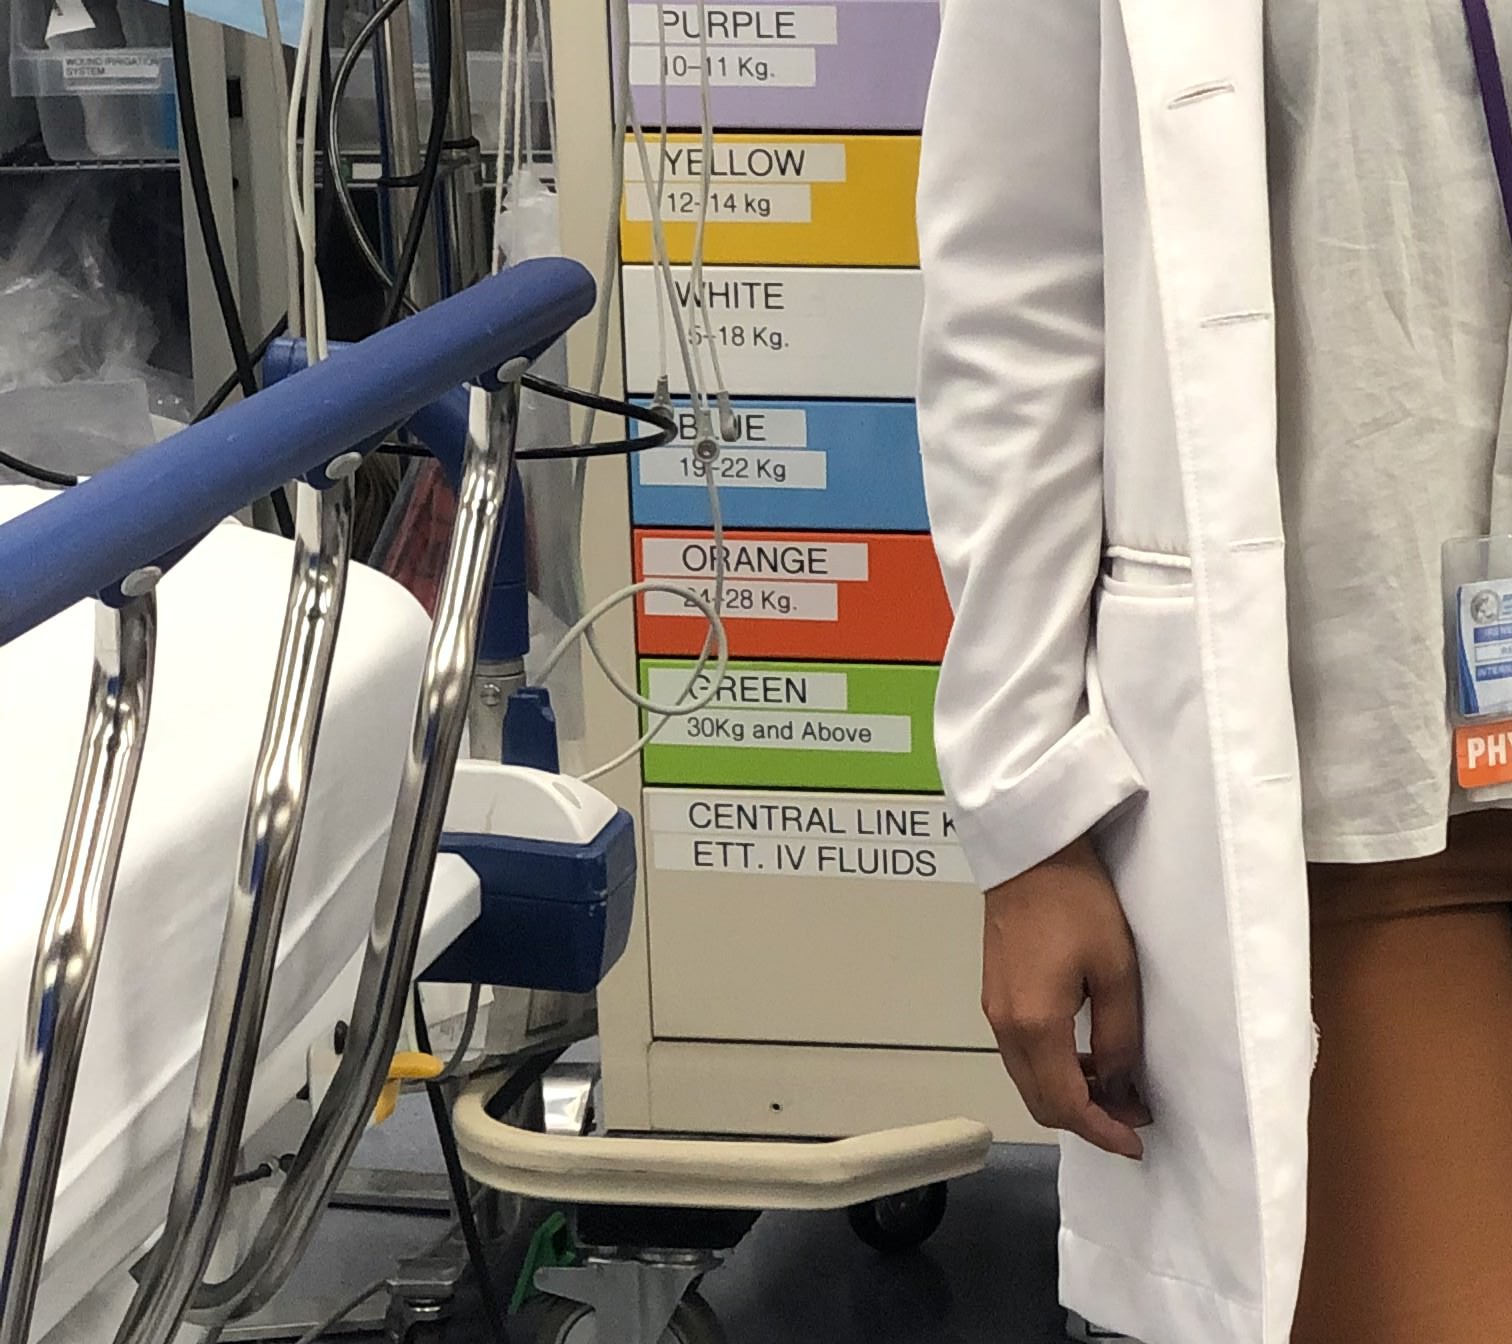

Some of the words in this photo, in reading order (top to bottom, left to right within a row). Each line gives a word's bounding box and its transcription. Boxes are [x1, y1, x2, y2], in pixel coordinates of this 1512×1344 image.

[662, 10, 797, 39] PURPLE
[65, 67, 105, 76] SYSTEM
[663, 55, 727, 78] 10-11
[738, 56, 776, 81] Kg.
[663, 148, 806, 177] YELLOW
[667, 191, 737, 214] 12-14
[744, 193, 771, 218] kg
[674, 281, 785, 310] WHITE
[687, 325, 746, 347] 5-18
[753, 326, 790, 351] Kg.
[679, 414, 767, 442] BE
[679, 457, 750, 479] 19-22
[756, 458, 787, 483] Kg
[681, 544, 829, 575] ORANGE
[761, 590, 798, 614] Kg.
[687, 674, 807, 704] GREEN
[687, 716, 745, 742] 30Kg
[752, 720, 793, 741] and
[801, 720, 872, 743] Above
[688, 801, 847, 834] CENTRAL
[856, 808, 931, 838] LINE
[693, 840, 764, 870] ETT.
[777, 844, 806, 871] IV
[818, 846, 937, 877] FLUIDS
